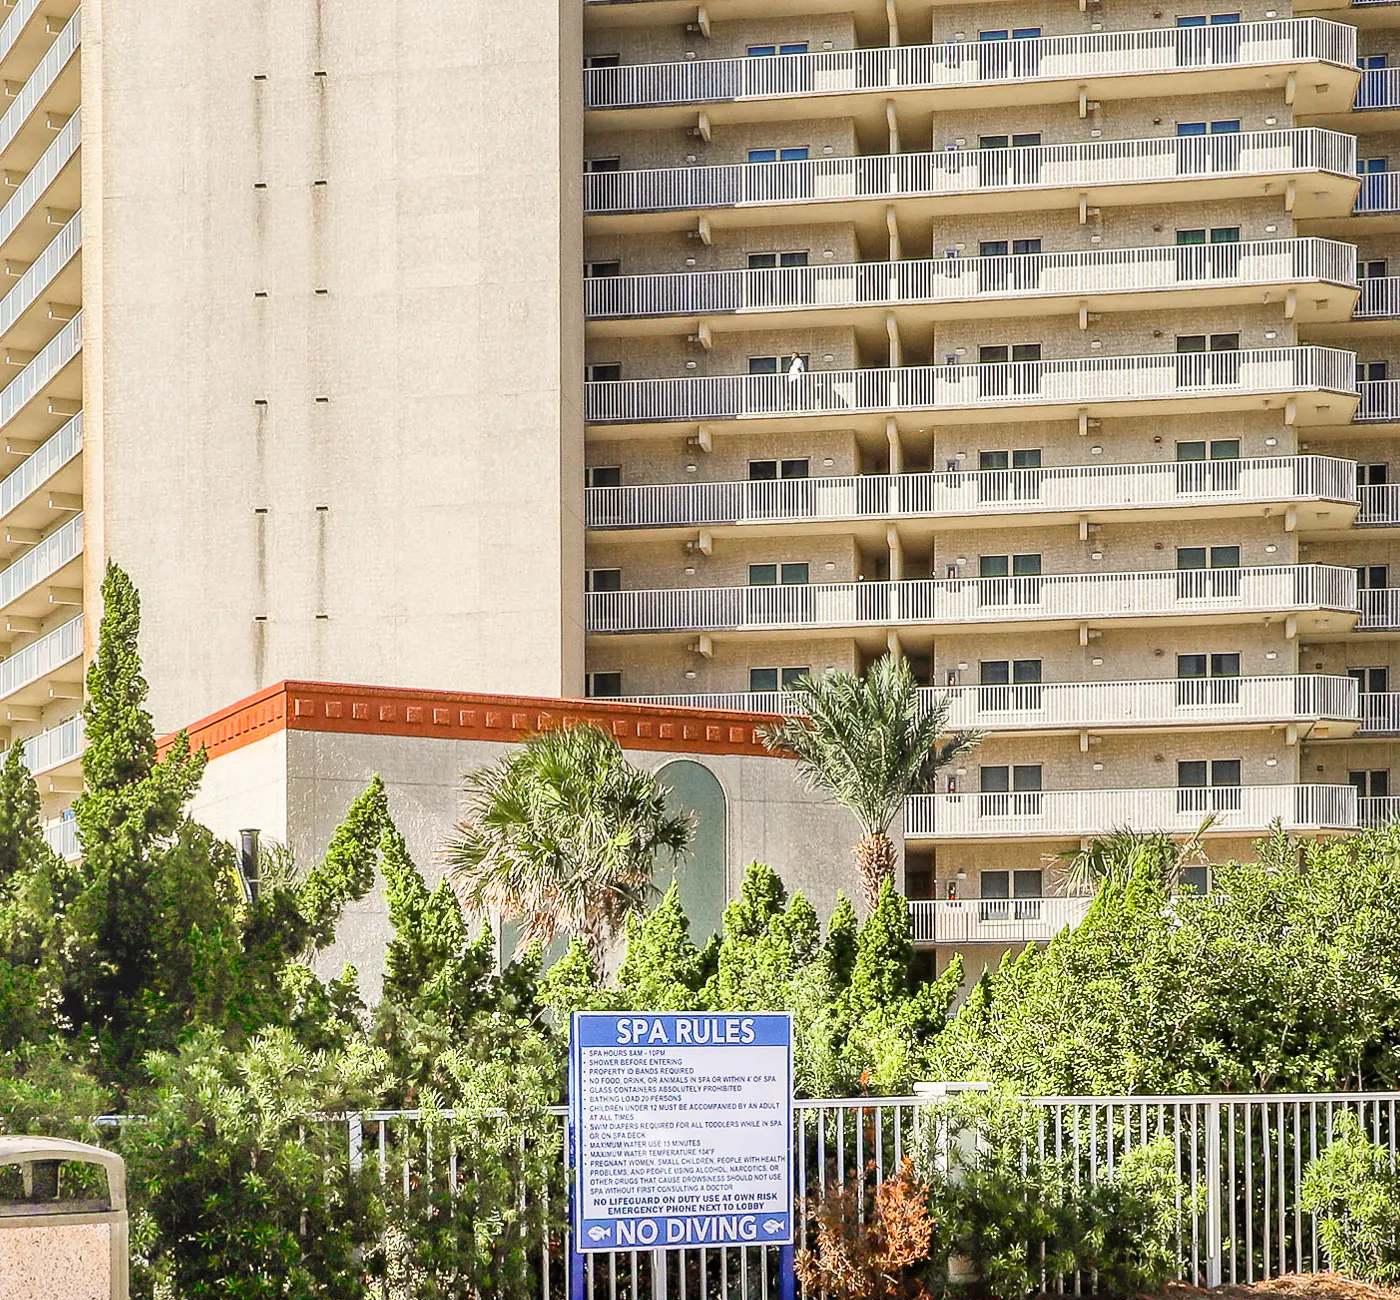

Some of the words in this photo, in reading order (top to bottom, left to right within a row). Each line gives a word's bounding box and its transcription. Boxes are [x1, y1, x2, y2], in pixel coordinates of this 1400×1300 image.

[616, 1018, 669, 1045] SPA
[676, 1018, 756, 1045] RULES
[682, 1175, 725, 1183] DROWSINESS
[657, 1185, 698, 1193] CONSULTING
[609, 1197, 660, 1206] LIFEGUARD
[663, 1196, 675, 1204] ON
[678, 1195, 700, 1203] DUTY
[722, 1194, 732, 1202] AT
[608, 1206, 663, 1215] EMERGENCY
[699, 1204, 721, 1212] NEXT
[723, 1203, 734, 1211] TO
[736, 1202, 764, 1210] LOBBY
[616, 1218, 659, 1245] NO
[667, 1215, 757, 1242] DIVING
